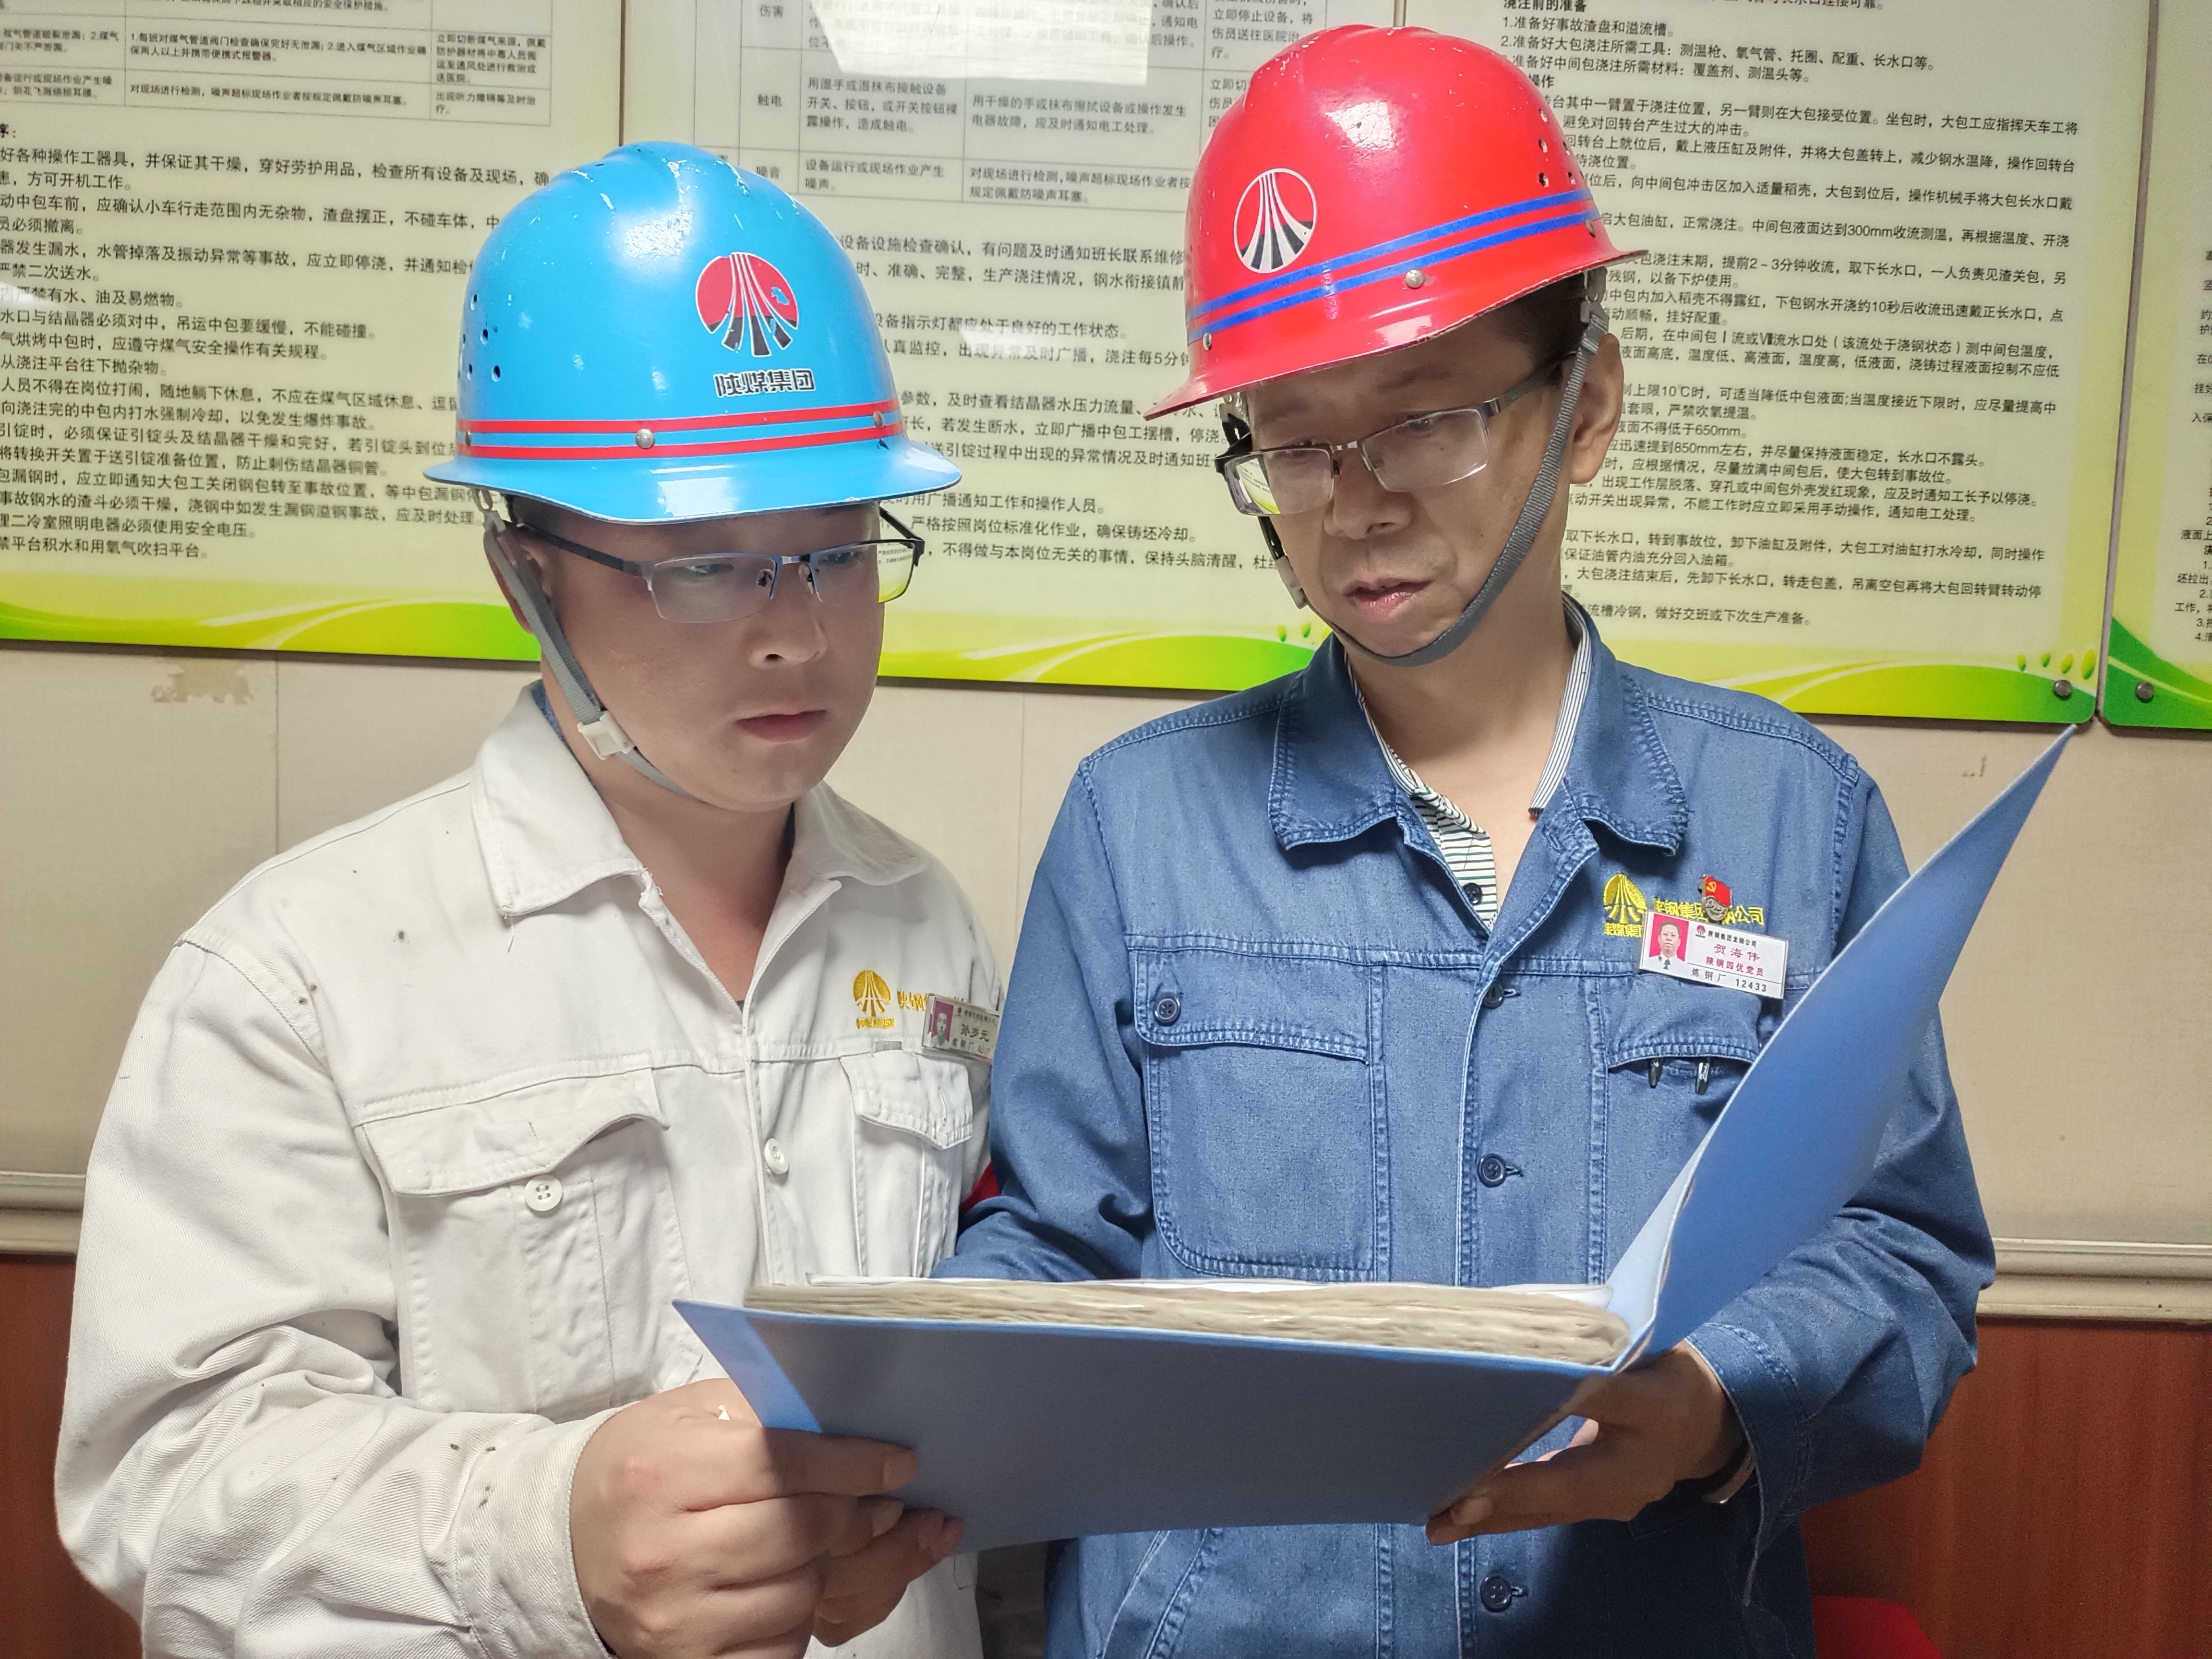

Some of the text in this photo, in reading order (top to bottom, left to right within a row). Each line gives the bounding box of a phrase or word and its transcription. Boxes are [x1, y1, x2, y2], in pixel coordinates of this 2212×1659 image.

[714, 369, 815, 397] 陕煤集团
[1735, 978, 1767, 992] 12433
